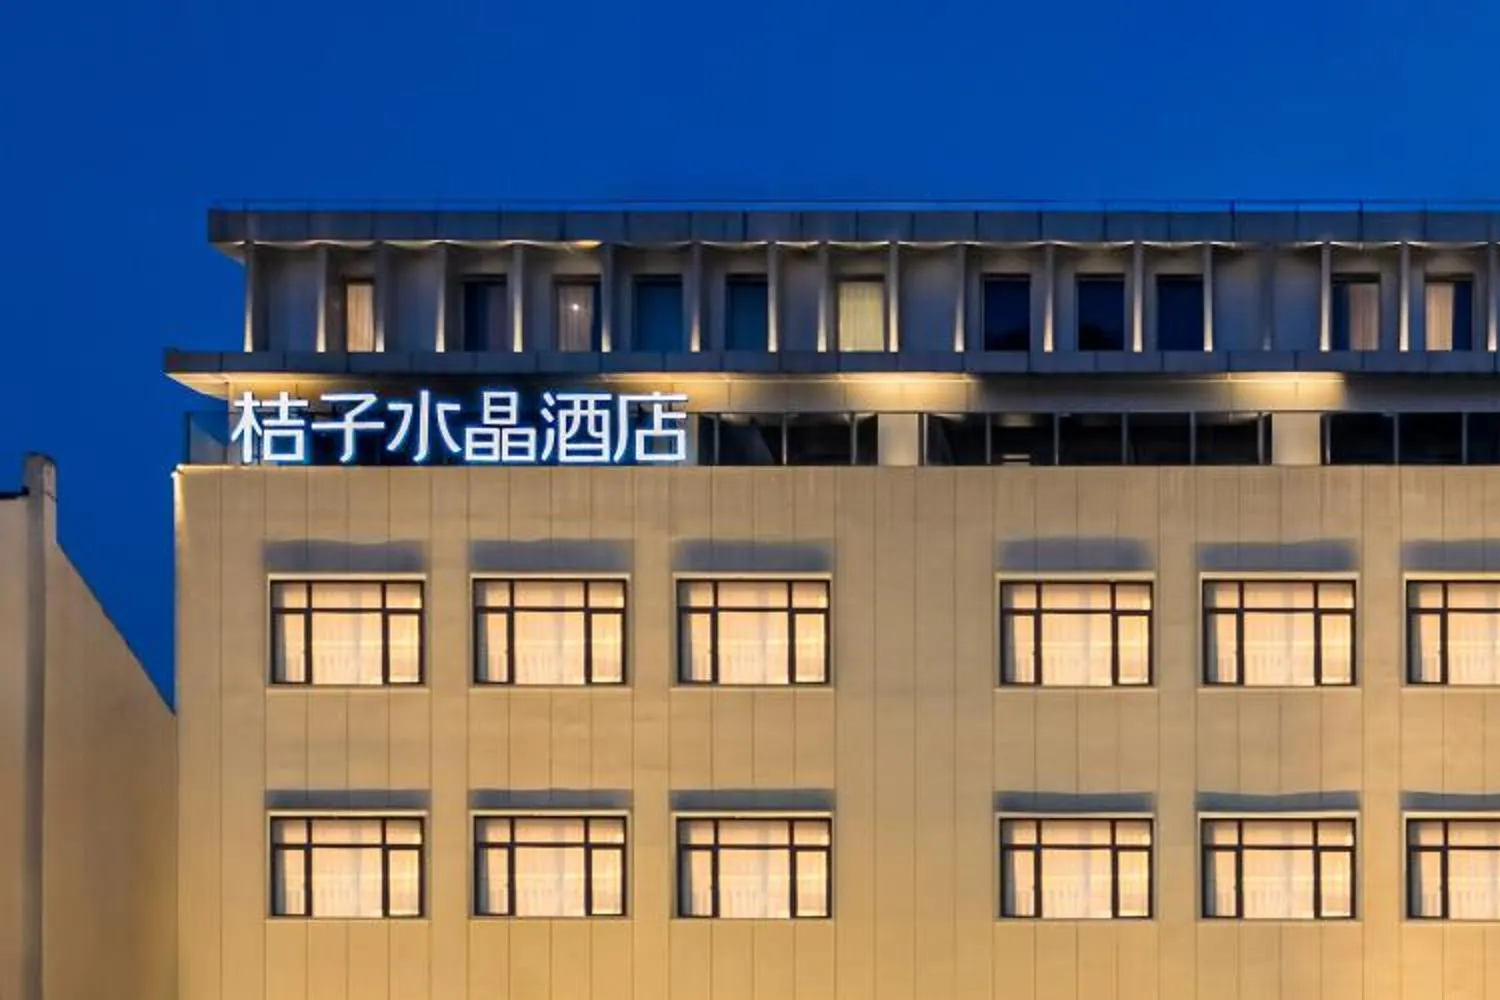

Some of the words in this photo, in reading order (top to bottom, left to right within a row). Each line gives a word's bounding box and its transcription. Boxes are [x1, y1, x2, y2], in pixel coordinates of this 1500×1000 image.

[231, 390, 689, 463] 桔子水晶酒店
